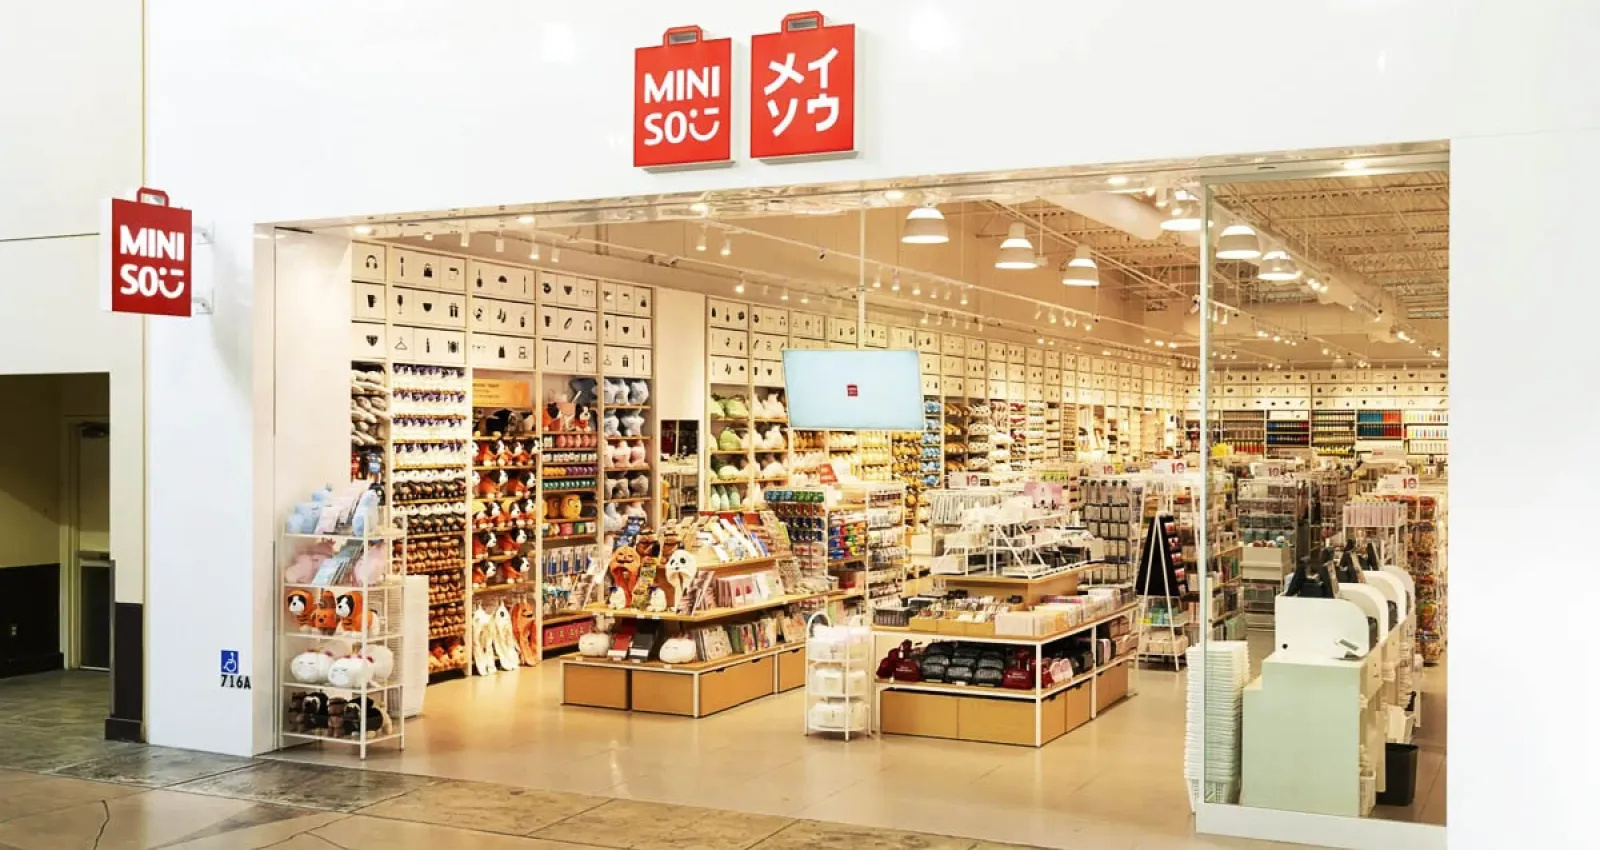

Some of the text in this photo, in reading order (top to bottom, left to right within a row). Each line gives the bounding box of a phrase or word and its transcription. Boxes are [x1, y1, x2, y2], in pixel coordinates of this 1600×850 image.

[644, 66, 720, 104] MINI
[763, 47, 839, 96] メイ
[767, 93, 840, 137] ソウ
[119, 224, 185, 262] MINI
[220, 674, 251, 689] 716A
